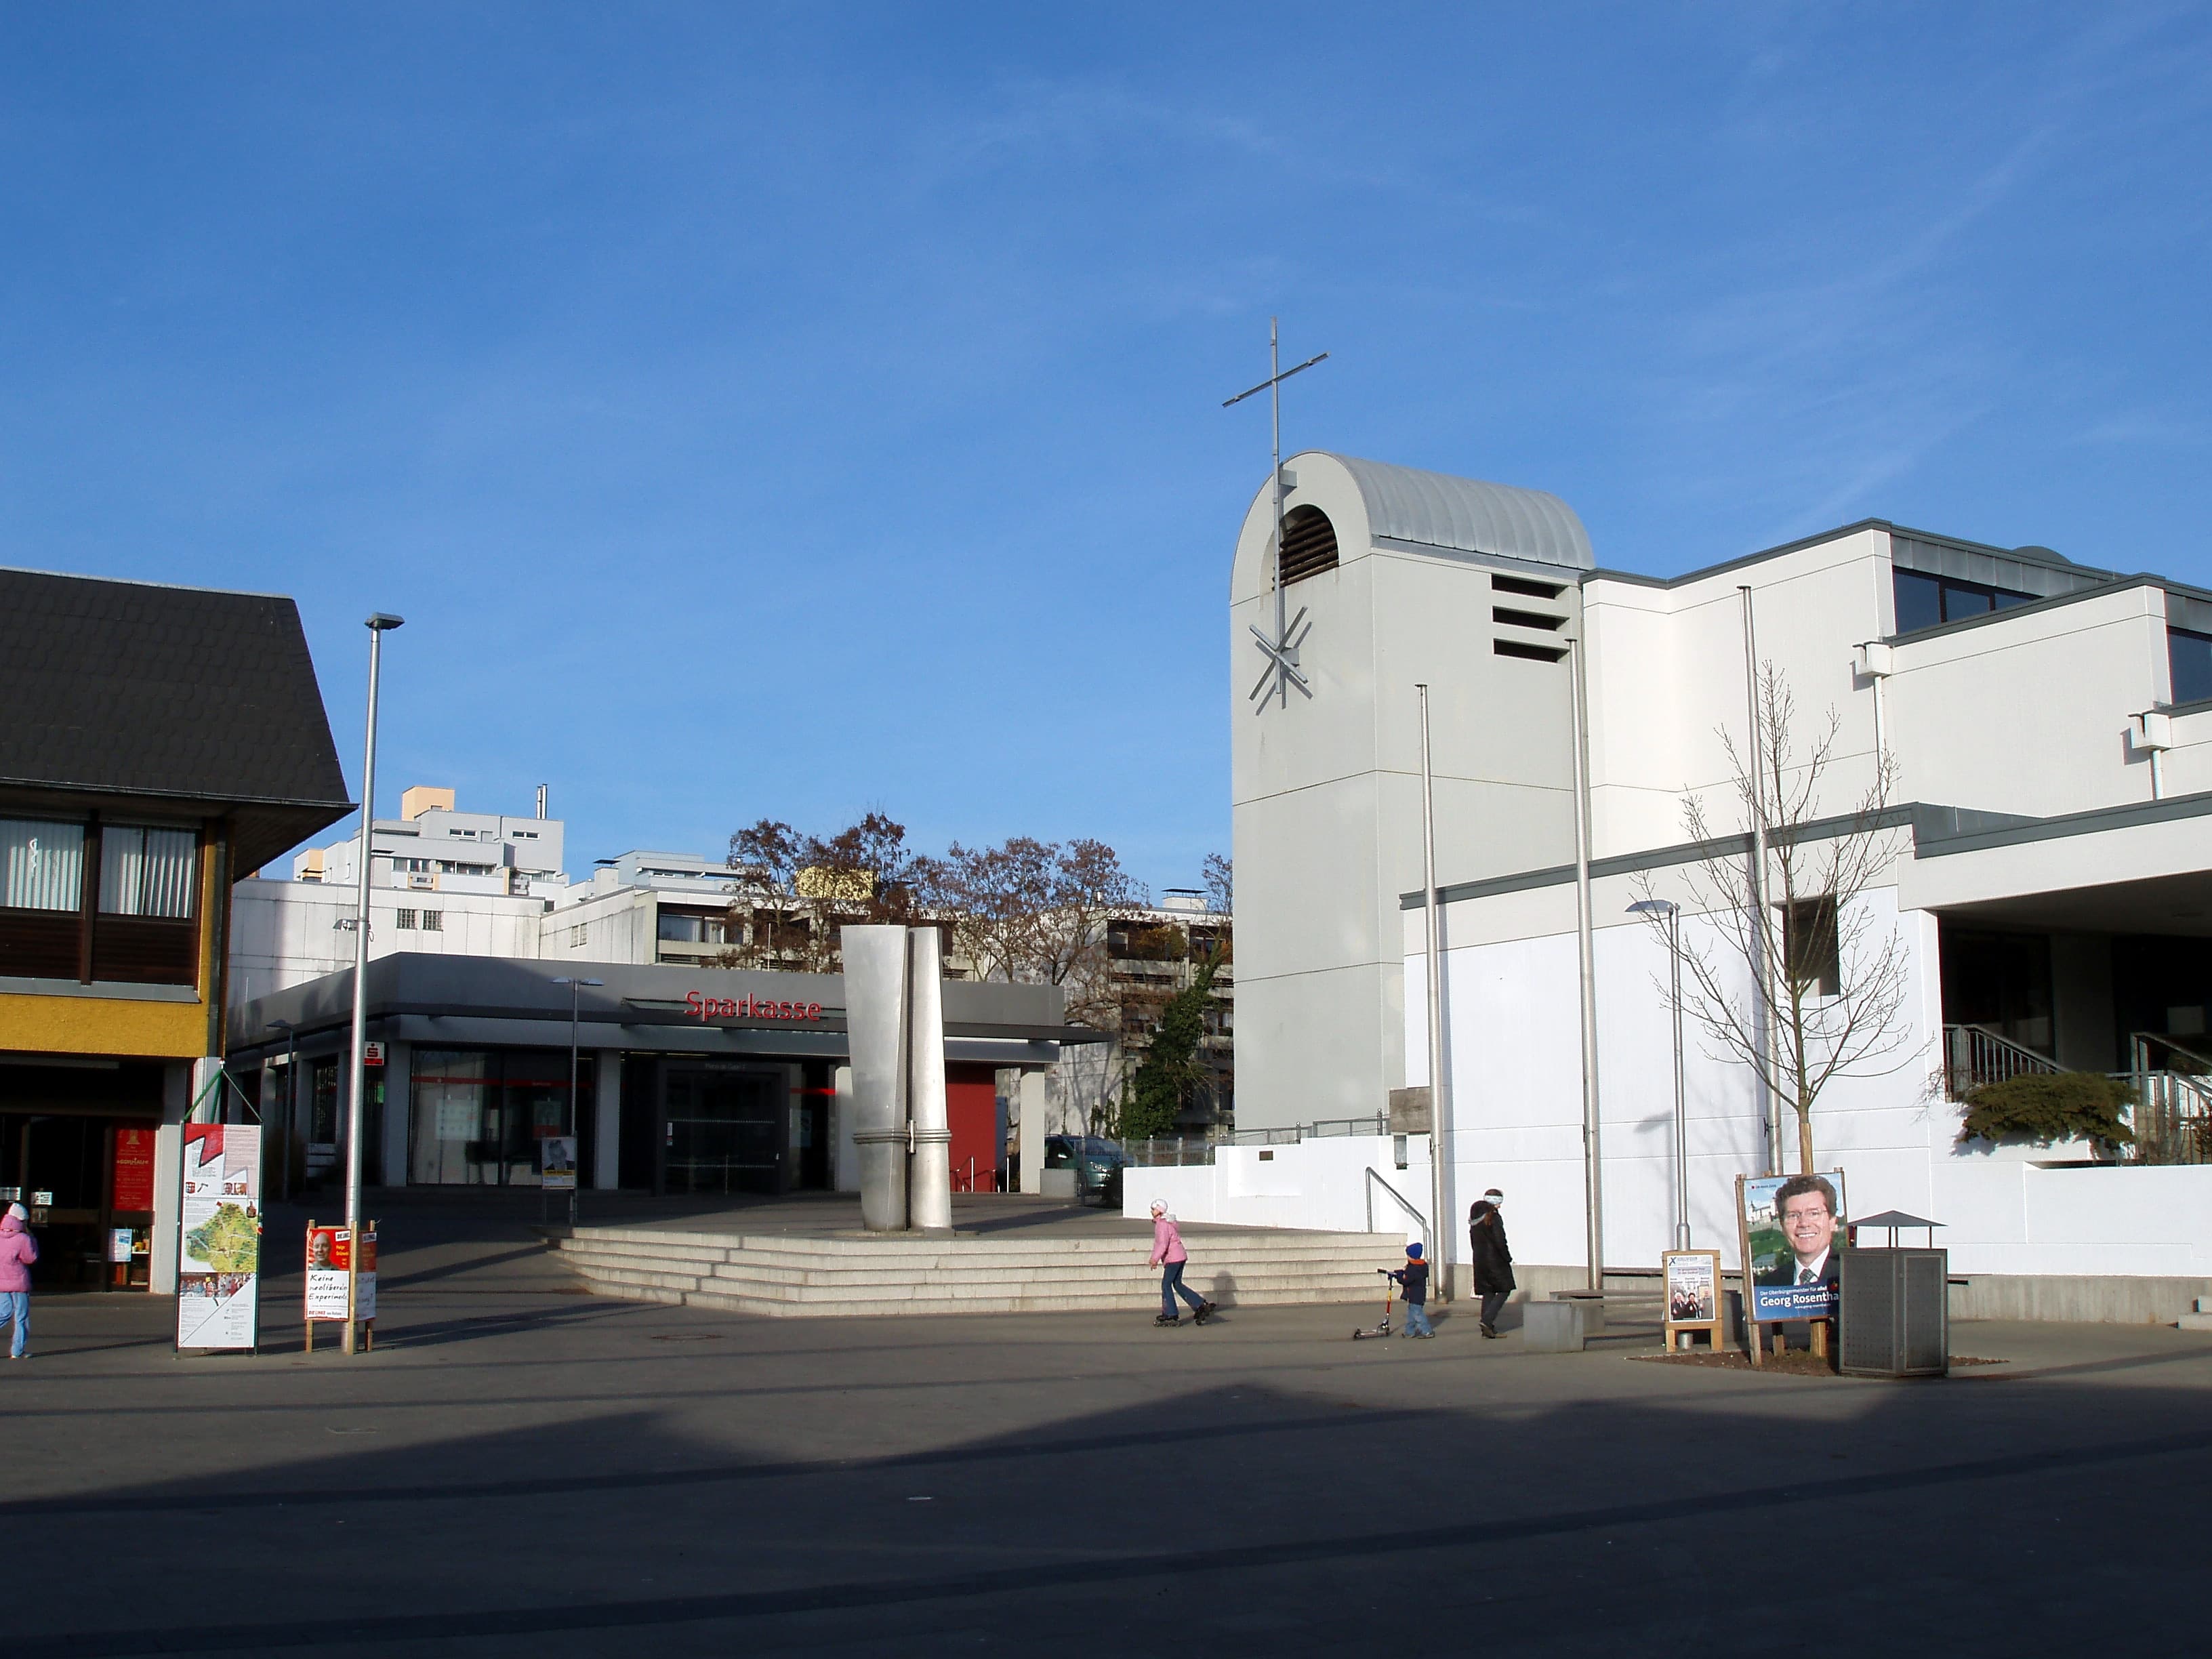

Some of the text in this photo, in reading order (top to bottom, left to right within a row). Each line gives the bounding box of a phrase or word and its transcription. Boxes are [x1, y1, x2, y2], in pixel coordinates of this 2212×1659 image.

[684, 990, 821, 1021] Sparkasse
[1760, 1291, 1839, 1308] Georg Rosentha
